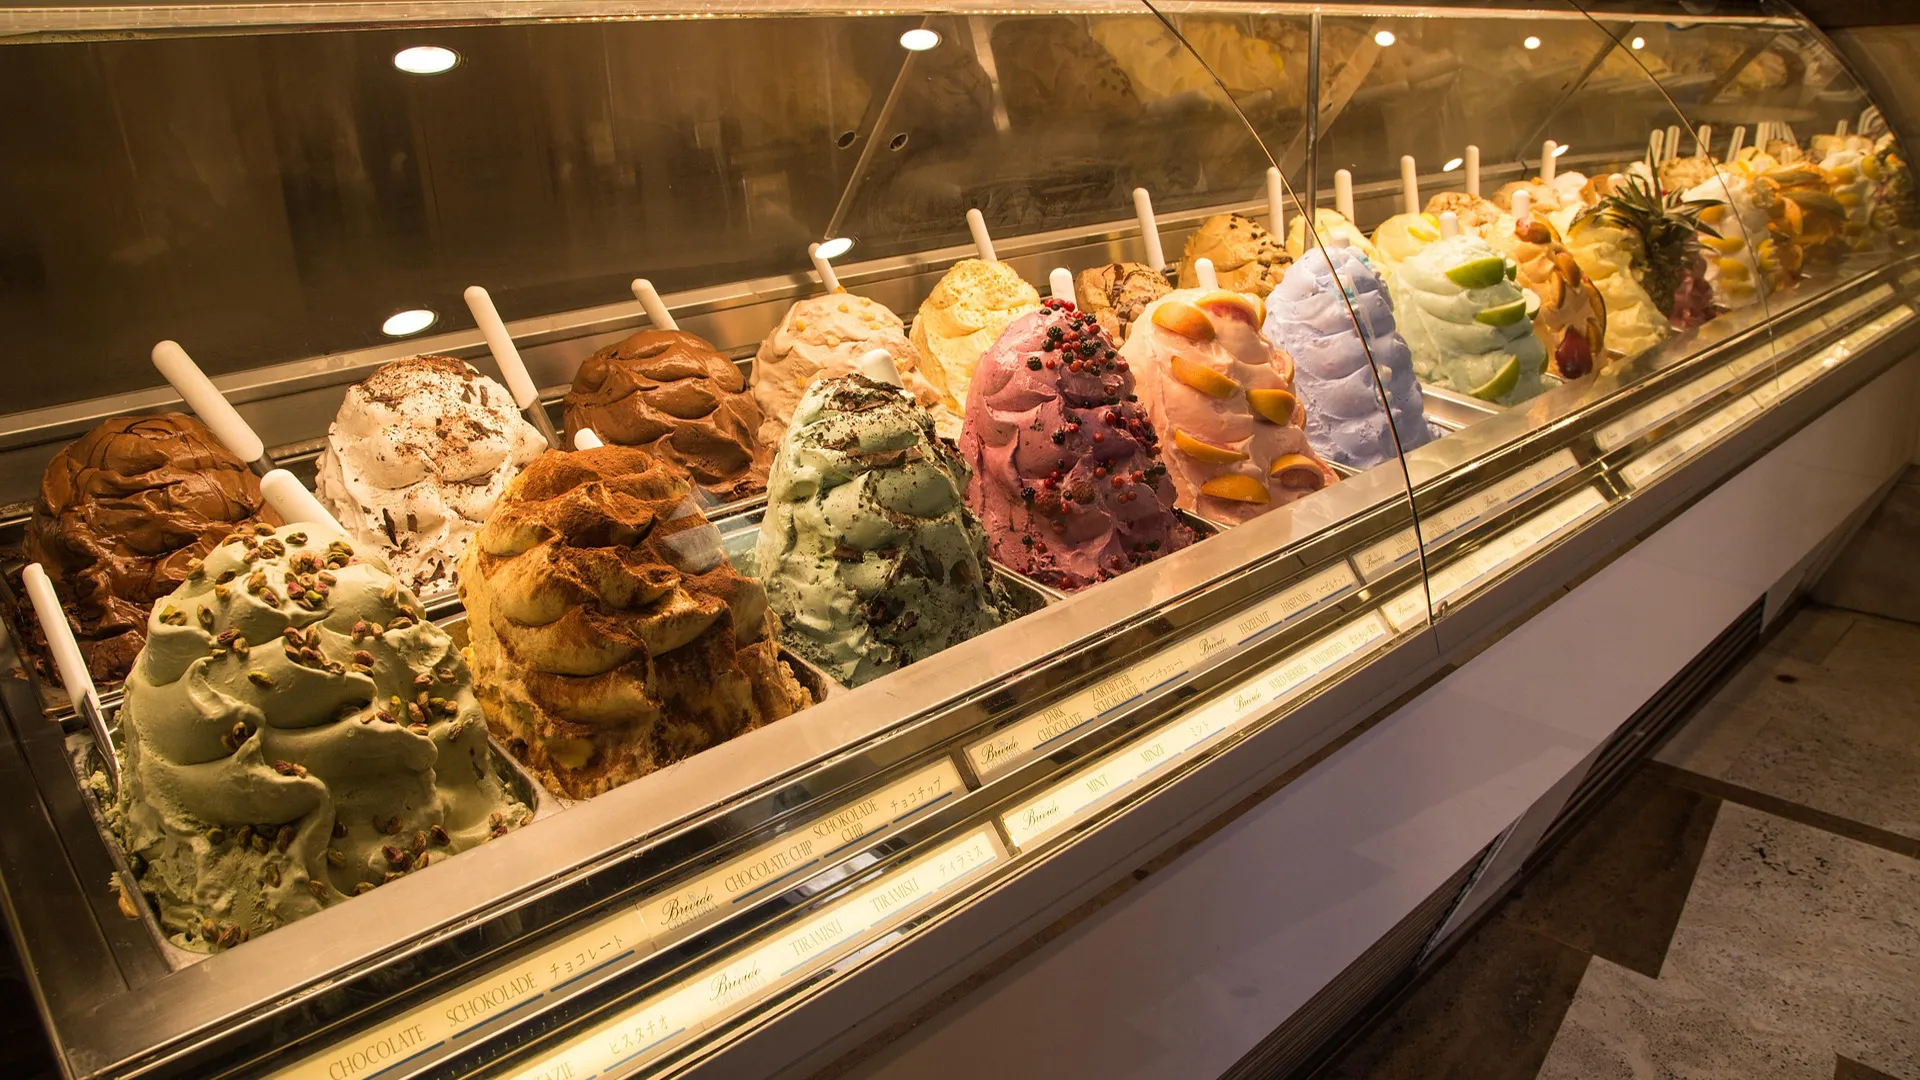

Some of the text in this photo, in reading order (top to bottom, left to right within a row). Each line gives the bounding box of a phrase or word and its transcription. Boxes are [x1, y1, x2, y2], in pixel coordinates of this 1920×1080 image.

[1238, 611, 1271, 635] HAZELNUT
[1089, 675, 1133, 700] ZARTBITTER
[1094, 685, 1140, 714] SCHOKOLADE
[1037, 711, 1084, 742] CHOCOLATE
[1042, 706, 1067, 726] DARK
[890, 776, 943, 812] チョコチップ
[1086, 774, 1110, 794] MINT
[812, 798, 879, 840] SCHOKOLADE
[841, 822, 865, 844] CHIP
[725, 840, 813, 893] CHOCOLATE CHIP
[939, 844, 984, 878] ティラミス
[661, 886, 713, 925] Brivido
[869, 877, 920, 913] TIRAMISU
[789, 919, 843, 956] TIRAMISU
[549, 934, 624, 980] チョコレート
[446, 972, 539, 1027] SCHOKOLADE
[329, 1023, 427, 1080] CHOCOLATE
